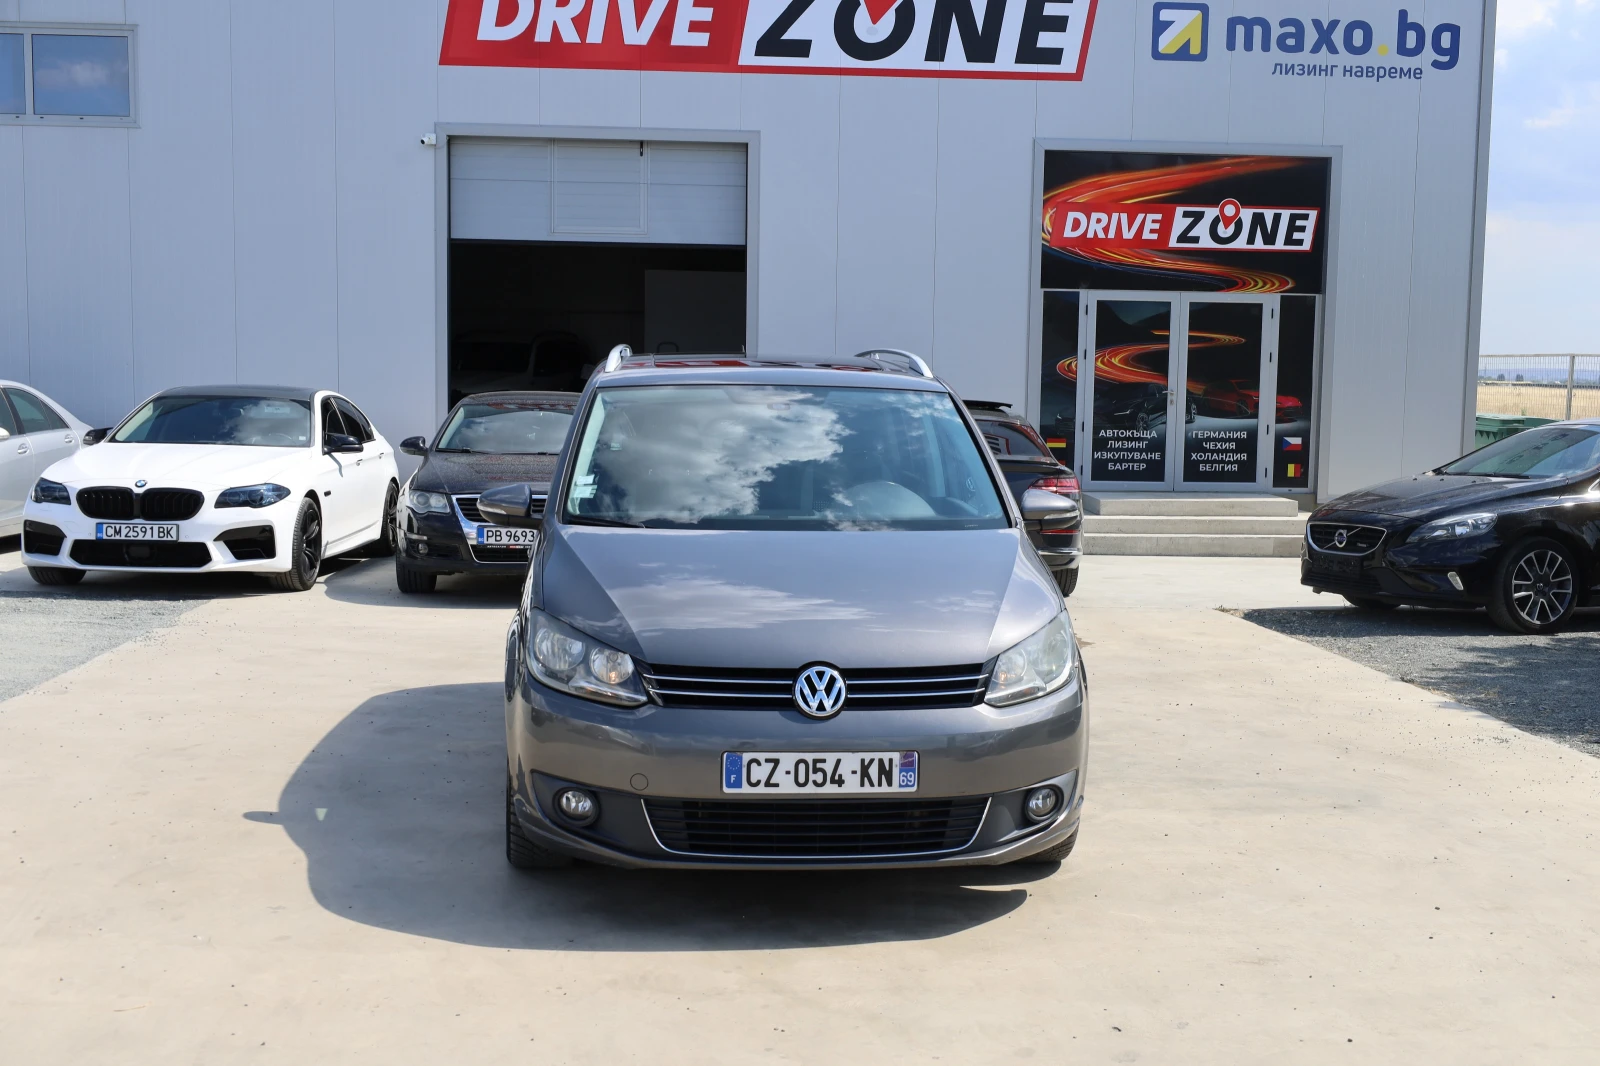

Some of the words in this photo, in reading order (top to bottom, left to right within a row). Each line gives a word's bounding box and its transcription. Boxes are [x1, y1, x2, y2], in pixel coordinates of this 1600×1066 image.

[476, 0, 714, 47] DRIVE
[754, 0, 1073, 65] ZONE
[1226, 8, 1460, 71] maxo.bg
[1271, 62, 1338, 77] лизинг
[1342, 63, 1423, 82] навреме
[1063, 211, 1163, 240] DRIVE
[1175, 210, 1310, 247] ZONE
[1098, 429, 1158, 439] АВТОКЪЩА
[1192, 430, 1247, 439] ГЕРМАНИЯ
[1107, 440, 1149, 449] ЛИЗИНГ
[1202, 441, 1236, 450] ЧЕХИЯ
[1093, 451, 1162, 460] ИЗКУПУВАНЕ
[1190, 452, 1248, 462] ХОЛАНДИЯ
[1108, 462, 1147, 471] БАРТЕР
[1199, 463, 1238, 472] БЕЛГИЯ
[105, 525, 122, 538] CM
[124, 525, 154, 539] 2591
[157, 526, 174, 539] BK
[486, 529, 503, 543] PB
[505, 530, 535, 543] 9693
[730, 774, 737, 784] F
[745, 758, 894, 788] CZ-054-KN
[899, 772, 916, 786] 69
